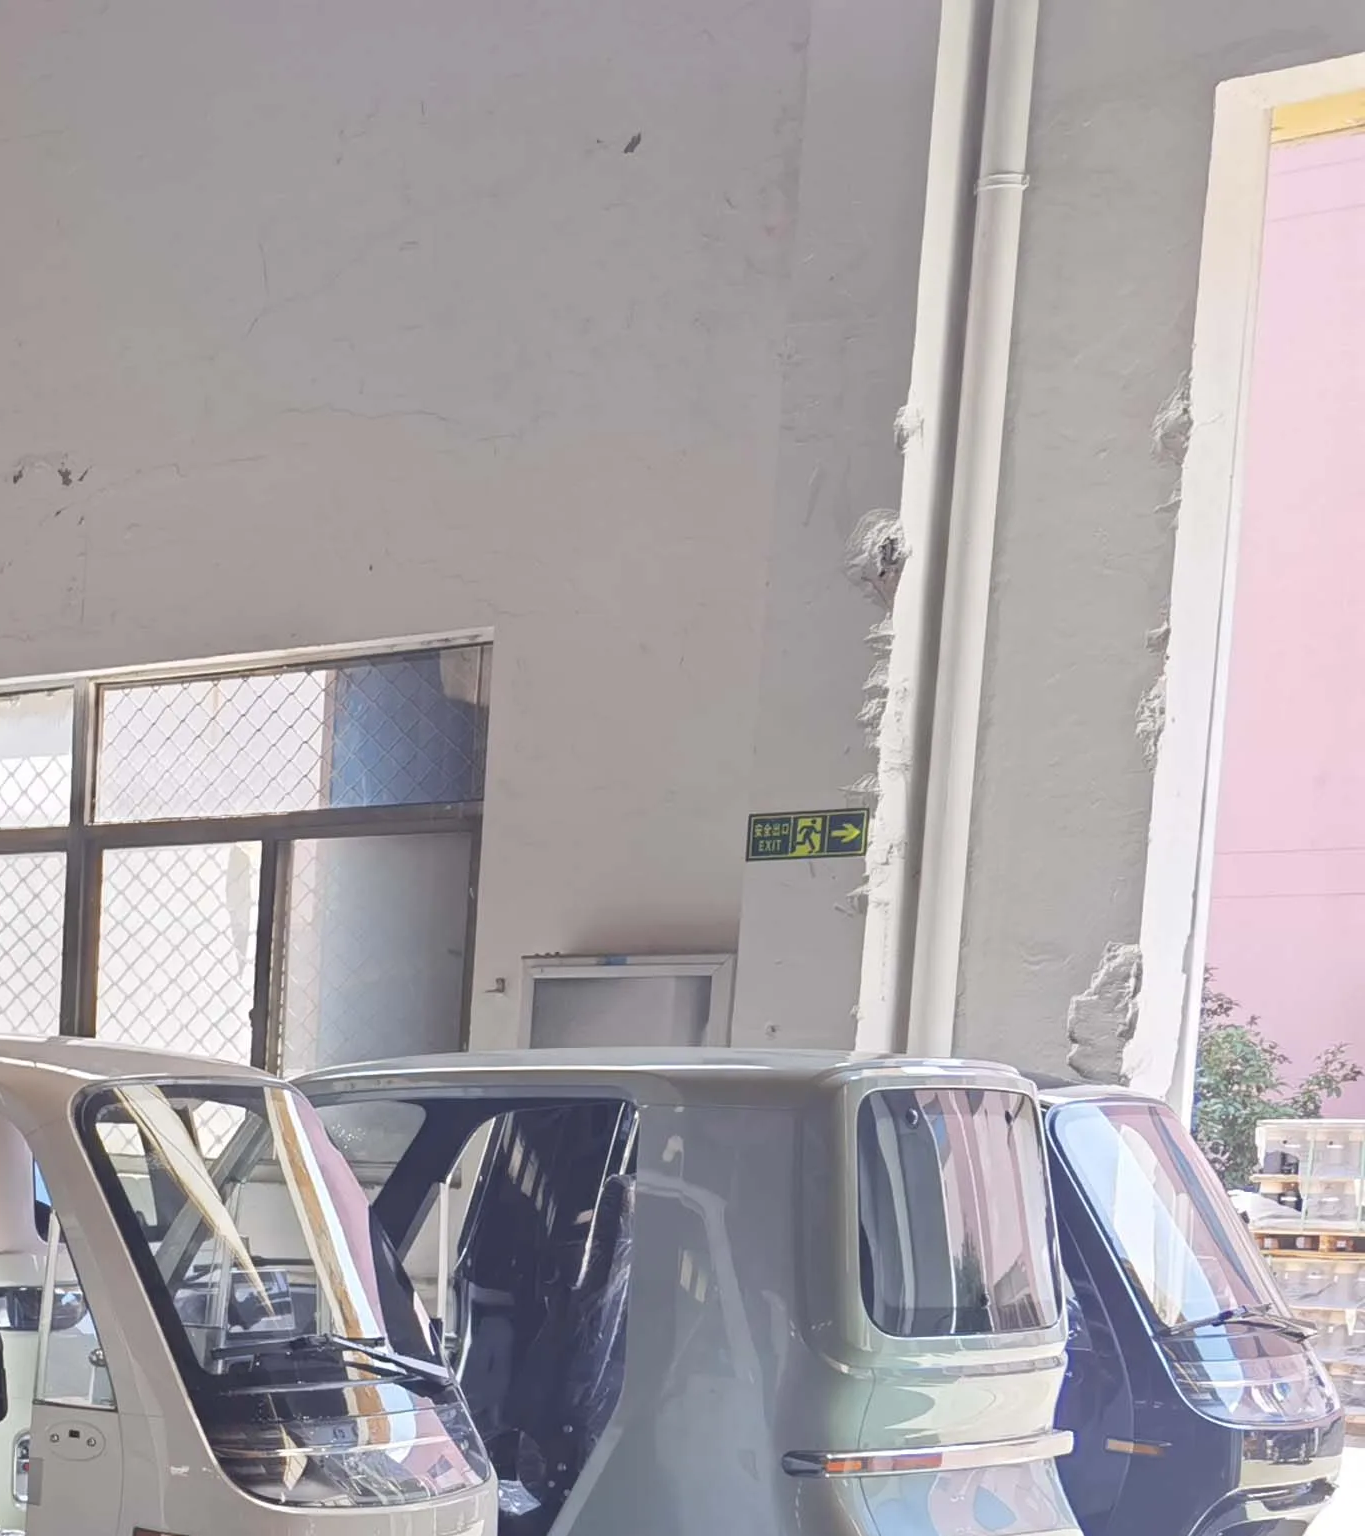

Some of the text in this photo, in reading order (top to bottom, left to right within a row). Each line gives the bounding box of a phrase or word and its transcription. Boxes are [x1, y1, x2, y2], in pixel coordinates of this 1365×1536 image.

[754, 823, 789, 838] 安全出口
[758, 839, 782, 852] EXIT
